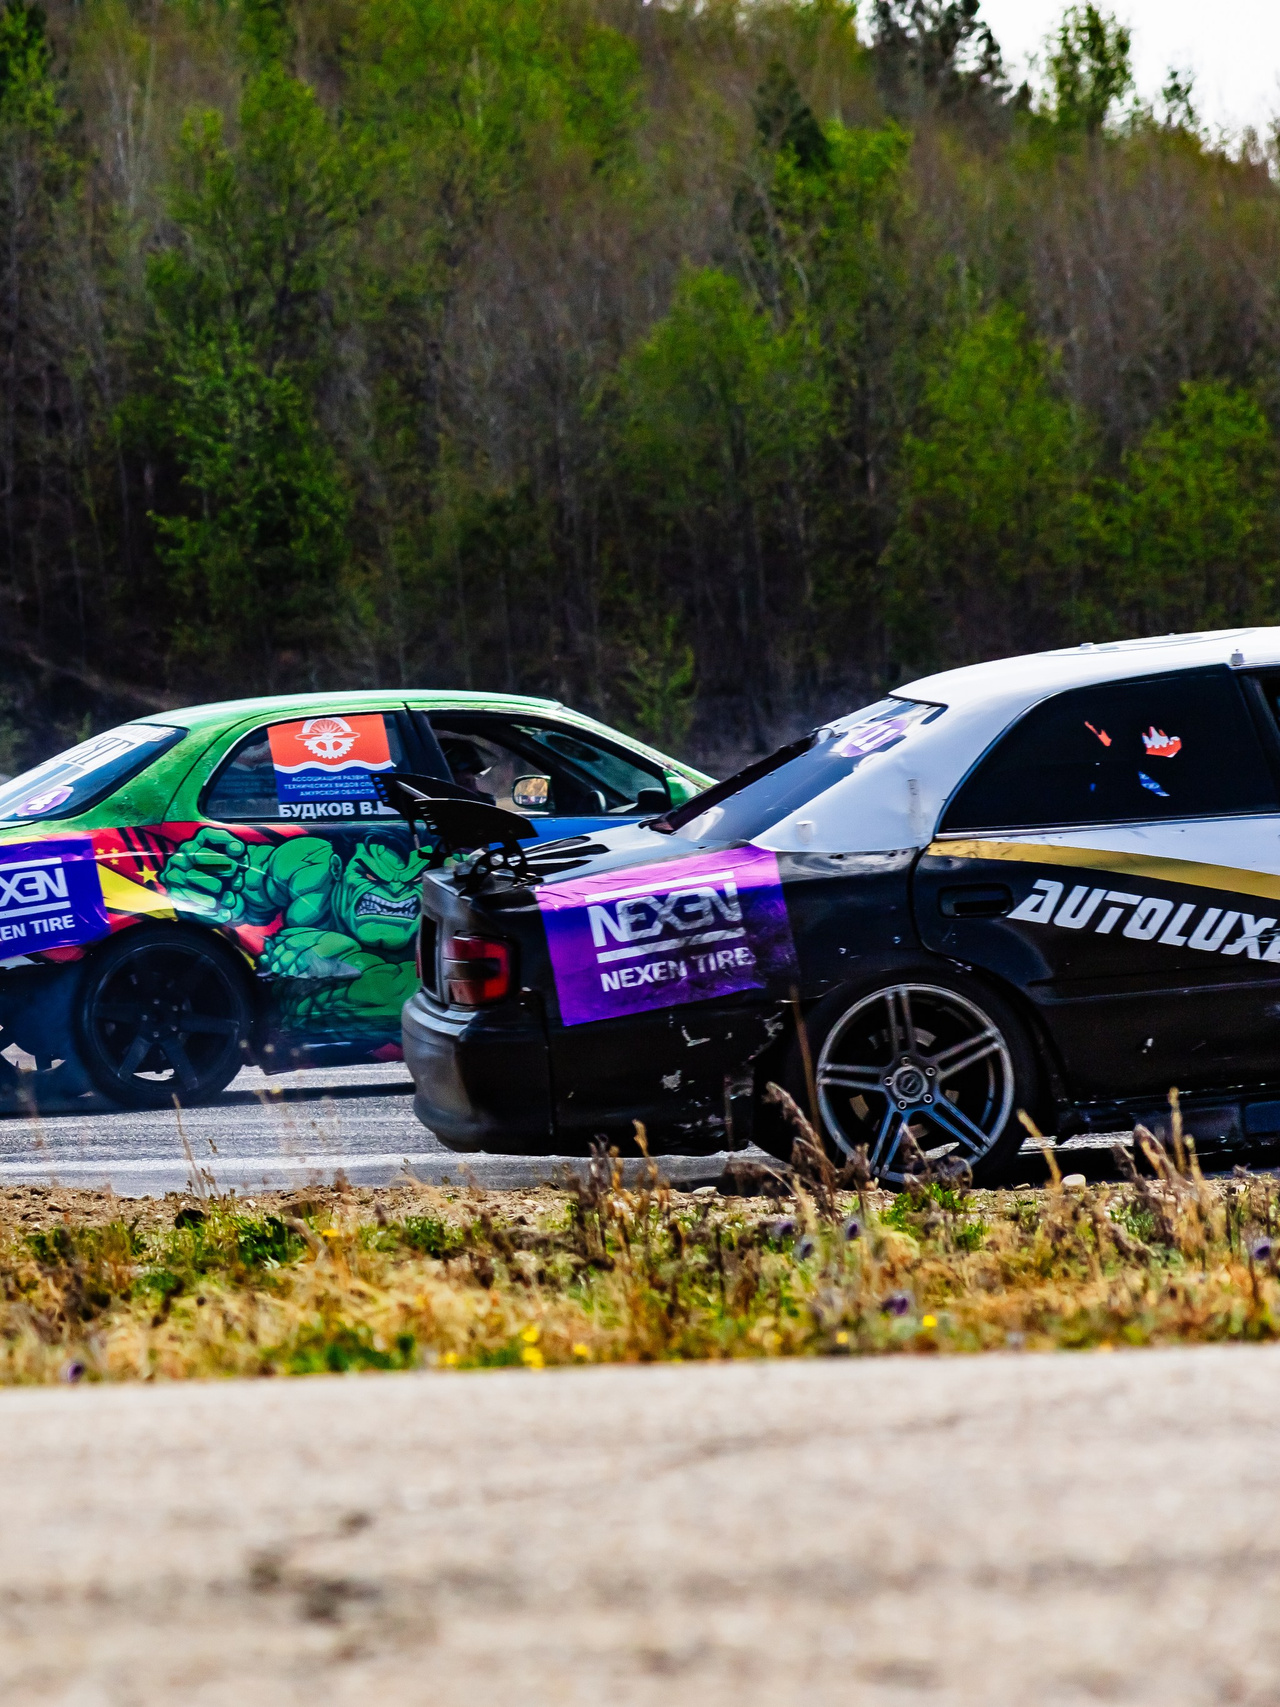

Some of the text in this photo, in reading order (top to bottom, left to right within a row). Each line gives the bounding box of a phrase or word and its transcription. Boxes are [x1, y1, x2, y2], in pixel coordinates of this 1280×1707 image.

[279, 802, 355, 819] БУДКОВ
[29, 914, 76, 935] TIRE
[587, 881, 743, 948] NEXEN
[1006, 879, 1280, 963] AUTOLUX
[600, 946, 757, 992] NEXEN TIRE
